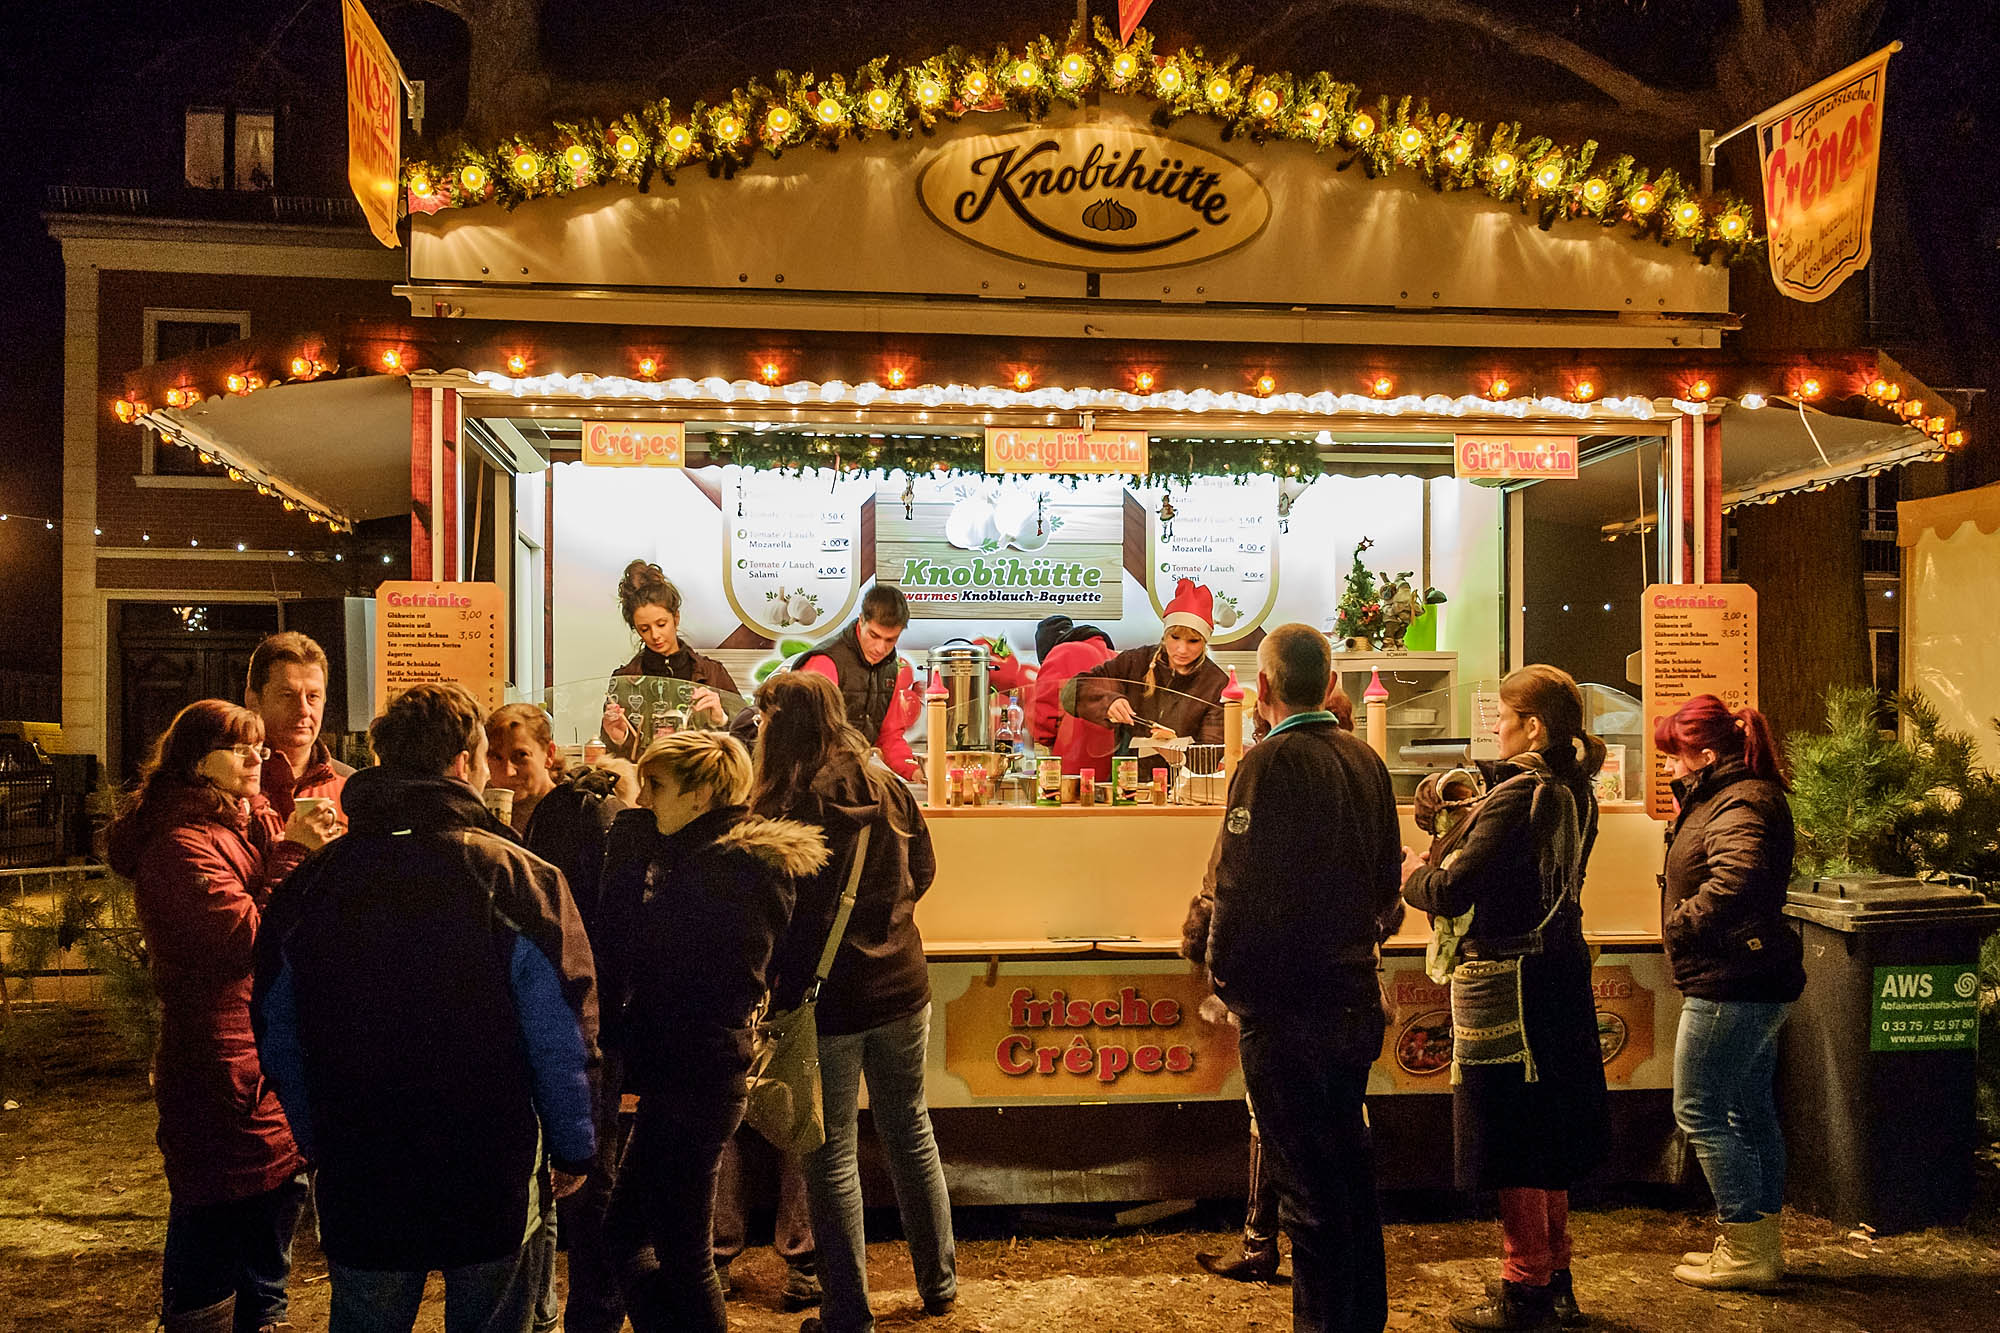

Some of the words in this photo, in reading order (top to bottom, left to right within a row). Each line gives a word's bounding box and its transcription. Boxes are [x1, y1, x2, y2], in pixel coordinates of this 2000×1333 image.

[1793, 80, 1871, 147] Französische
[1768, 103, 1875, 240] Crêpes
[954, 140, 1231, 252] Knobihütte
[590, 424, 678, 460] Crêpes
[995, 432, 1141, 467] Obstglühwein
[1462, 441, 1571, 469] Glühwein
[749, 541, 791, 549] Mozarella
[1172, 535, 1201, 543] Tomate
[1210, 535, 1235, 543] Lauch
[1172, 545, 1212, 553] Mozarella
[789, 560, 815, 569] Lauch
[1172, 564, 1202, 572] Tomate
[1210, 564, 1235, 572] Lauch
[749, 570, 778, 578] Salami
[901, 559, 1101, 587] Knobihütte
[387, 592, 472, 608] Getränke
[903, 591, 958, 601] warmes
[961, 590, 1101, 604] Knoblauch-Baguette
[1654, 595, 1728, 608] Getränke
[458, 611, 481, 621] 3,00
[458, 631, 481, 640] 3,50
[1880, 973, 1933, 998] AWS
[1008, 986, 1180, 1027] frische
[1881, 1021, 1890, 1031] 0
[1892, 1021, 1906, 1031] 33
[1909, 1021, 1923, 1031] 75
[1933, 1020, 1945, 1030] 52
[1948, 1020, 1961, 1030] 97
[1890, 1032, 1966, 1043] www.aws-kw.de
[995, 1034, 1193, 1082] Crêpes
